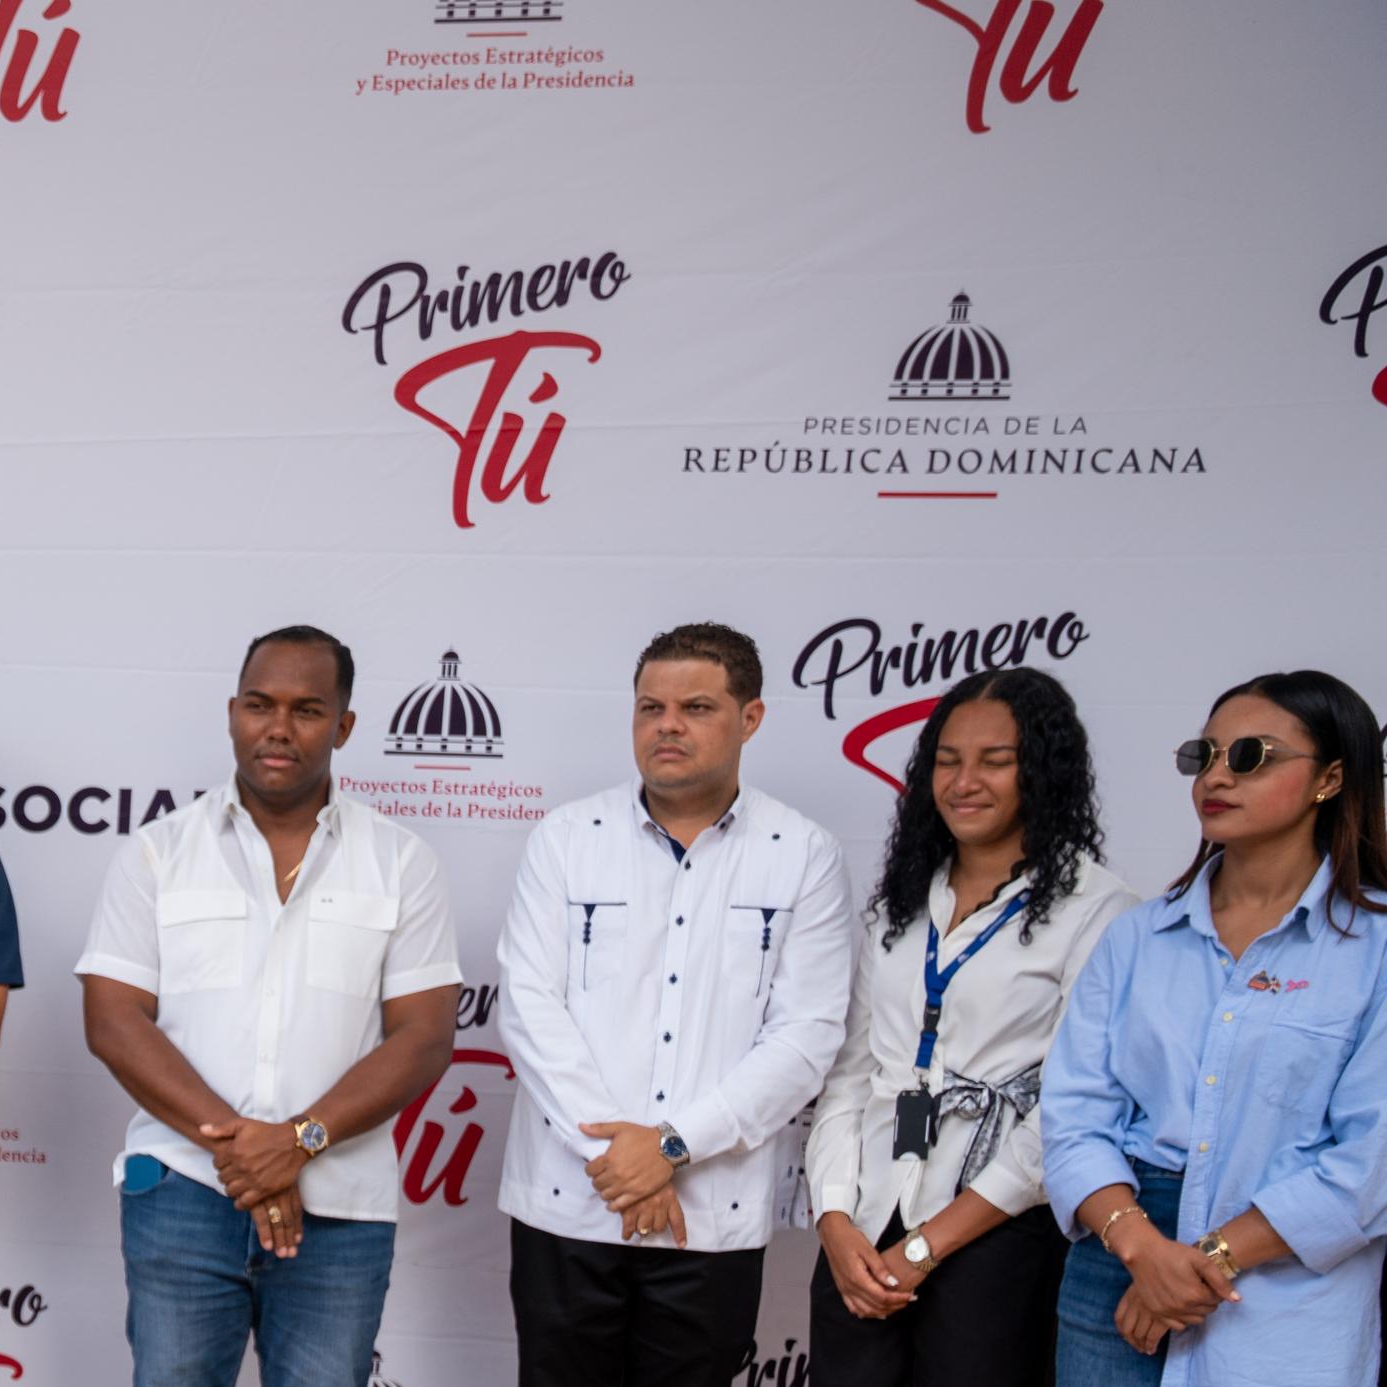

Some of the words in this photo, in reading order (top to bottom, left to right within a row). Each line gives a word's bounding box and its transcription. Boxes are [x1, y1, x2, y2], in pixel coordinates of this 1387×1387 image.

[386, 49, 480, 69] Proyectos
[486, 46, 604, 67] Estratégicos
[356, 79, 366, 96] y
[372, 72, 470, 95] Especiales
[474, 72, 496, 90] de
[501, 72, 517, 90] la
[523, 70, 635, 89] Presidencia
[341, 251, 631, 366] Primero
[394, 330, 602, 530] Tú
[803, 416, 990, 436] PRESIDENCIA
[1004, 416, 1040, 436] DE
[1053, 416, 1088, 436] LA
[682, 441, 910, 474] REPÚBLICA
[926, 447, 1208, 475] DOMINICANA
[792, 611, 1090, 720] Primero
[339, 776, 427, 797] Proyectos
[431, 778, 543, 799] Estratégicos
[421, 801, 443, 817] de
[447, 801, 462, 818] la
[467, 803, 548, 821] Presiden
